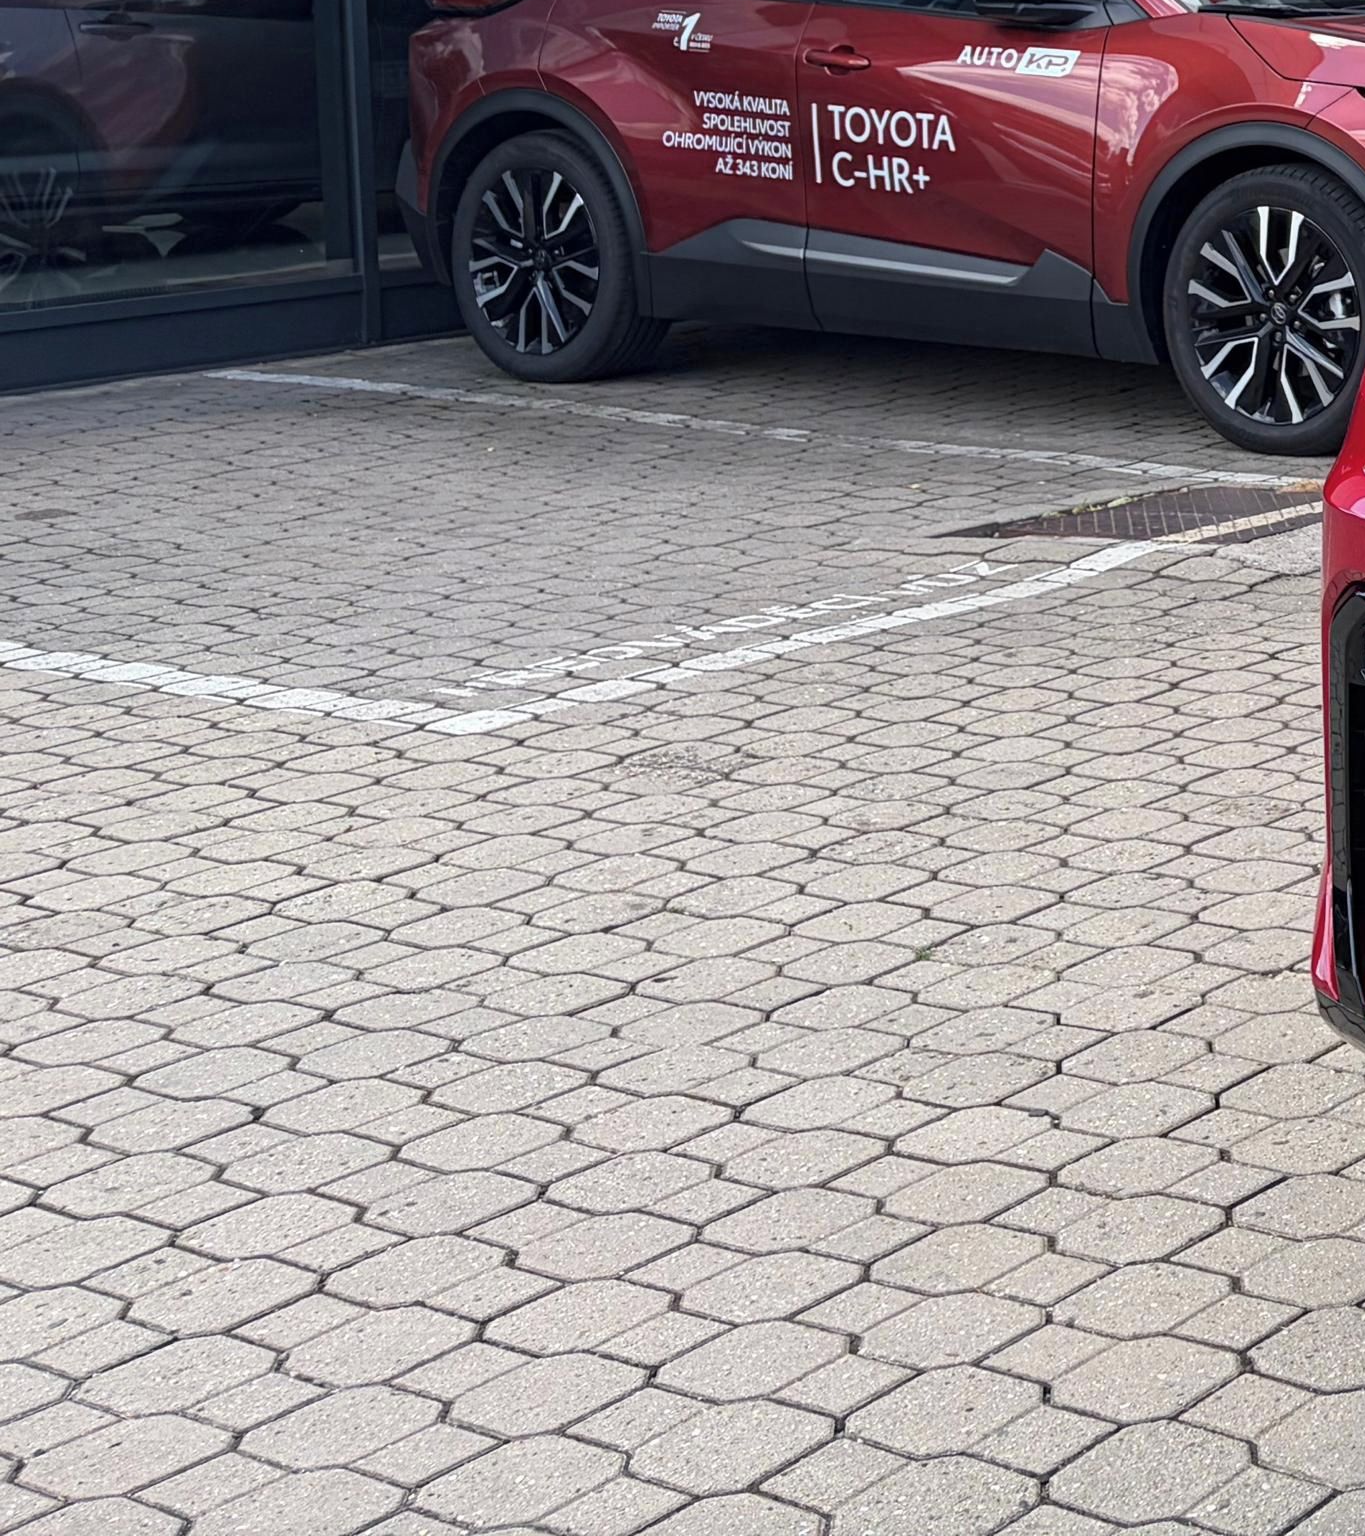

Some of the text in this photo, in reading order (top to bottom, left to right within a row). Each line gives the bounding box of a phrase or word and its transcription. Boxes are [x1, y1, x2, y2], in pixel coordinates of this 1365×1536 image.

[956, 45, 1018, 69] AUTO
[693, 90, 790, 116] VYSOKÁ KVALITA
[702, 113, 791, 137] SPOLEHLIVOST
[827, 105, 956, 152] TOYOTA
[662, 130, 792, 159] OHROMUJÍCÍ VÝKON
[715, 154, 793, 180] AŽ 343 KONÍ
[832, 151, 930, 194] C-HR+
